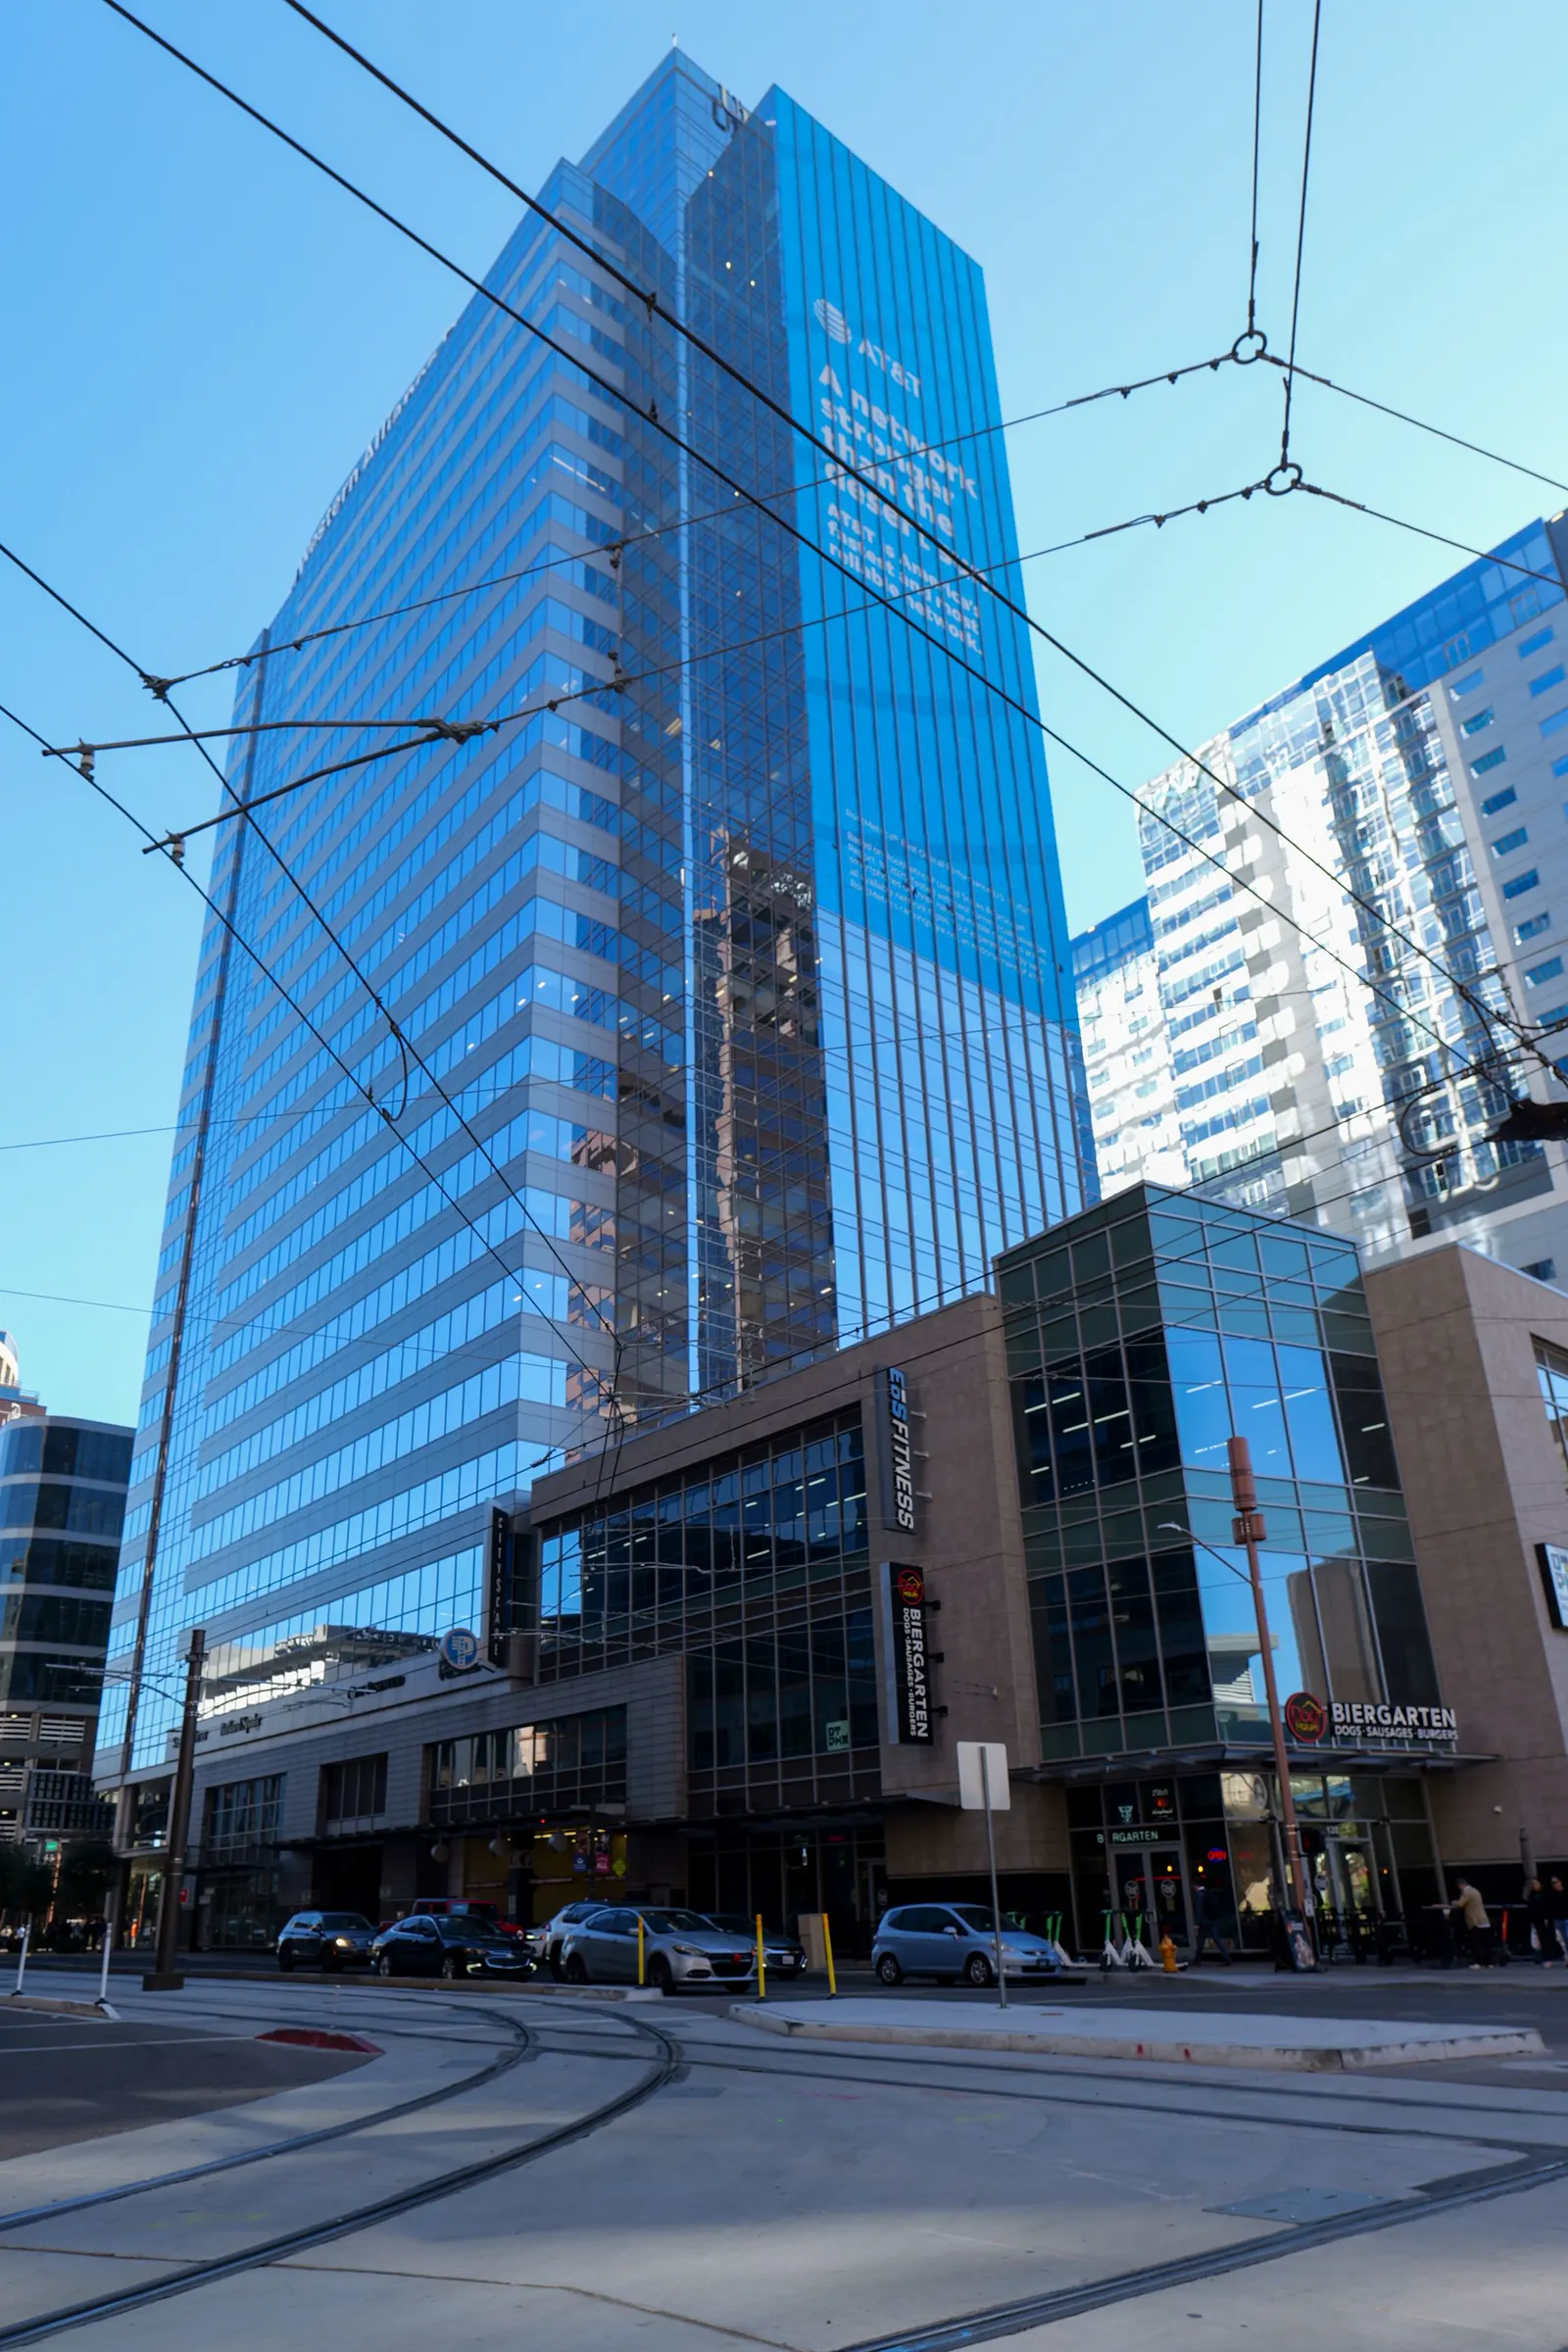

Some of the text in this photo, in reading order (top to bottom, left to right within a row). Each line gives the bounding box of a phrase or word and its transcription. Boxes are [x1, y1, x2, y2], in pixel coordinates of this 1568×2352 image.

[858, 337, 921, 399] AT&T
[818, 364, 978, 500] A network
[820, 397, 955, 507] stronger
[821, 424, 954, 538] than the
[824, 459, 930, 551] desert
[827, 503, 875, 543] AT&T
[892, 1418, 914, 1530] FITNESS
[905, 1639, 914, 1688] SAUSAGES
[909, 1608, 929, 1738] BIERGARTEN
[907, 1691, 917, 1737] BURGERS
[1331, 1702, 1457, 1729] BIERGARTEN
[1334, 1725, 1458, 1740] DOGS SAUSAGES BURGERS
